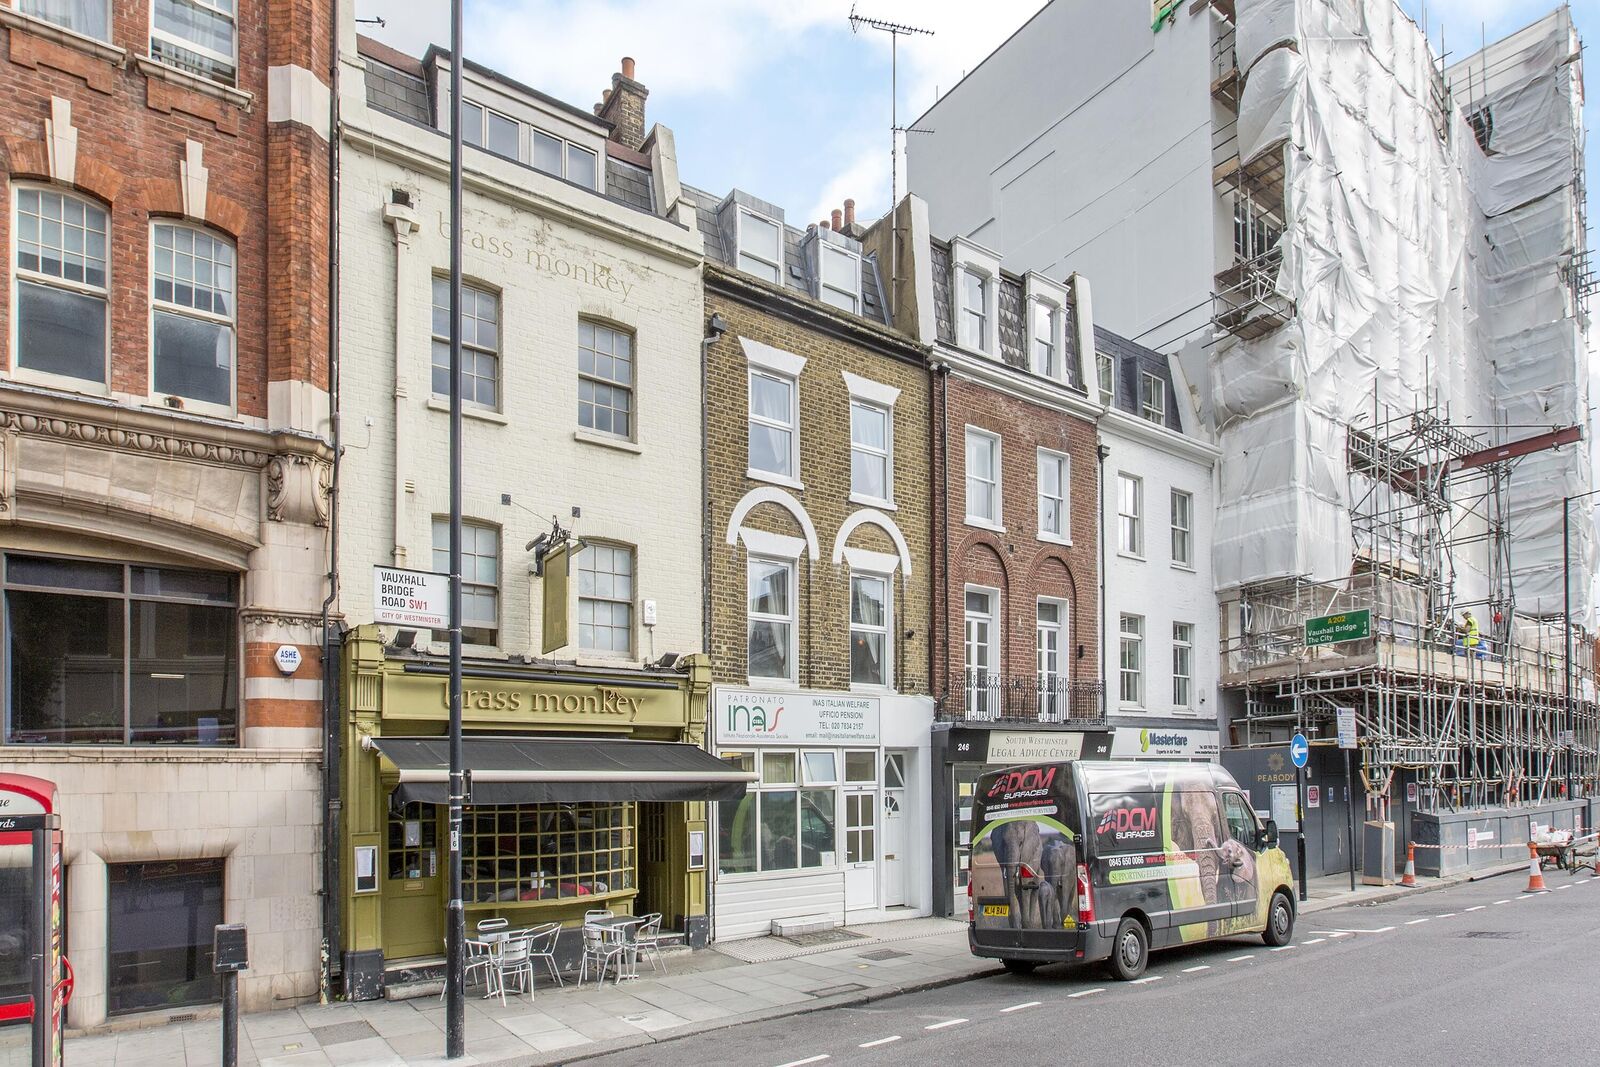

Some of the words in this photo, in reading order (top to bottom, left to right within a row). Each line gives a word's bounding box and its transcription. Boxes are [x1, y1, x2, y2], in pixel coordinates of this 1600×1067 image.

[526, 249, 634, 303] monkey
[381, 571, 427, 587] VAUXHALL
[381, 583, 415, 597] BRIDGE
[381, 596, 406, 608] ROAD
[408, 599, 428, 611] SW1
[381, 611, 394, 619] CITY
[403, 614, 441, 624] WESTMINSTER
[1327, 615, 1346, 625] A202
[1307, 626, 1335, 637] Vauxhall
[1335, 624, 1358, 632] Bridge
[1320, 634, 1334, 642] City
[280, 650, 297, 659] ASHE
[531, 685, 645, 722] monkey
[728, 694, 785, 705] PATRONATO
[812, 699, 825, 707] INAS
[826, 700, 845, 708] ITALIAN
[846, 701, 870, 709] WELFARE
[819, 711, 840, 719] UFFICIO
[840, 712, 864, 720] PENSIONI
[819, 722, 830, 730] TEL:
[831, 722, 840, 730] 020
[1005, 735, 1027, 745] SOUTH
[1028, 736, 1068, 745] WESTMINSTER
[1149, 732, 1188, 746] Masterfare
[991, 747, 1017, 758] LEGAL
[1019, 747, 1048, 758] ADVICE
[1049, 747, 1079, 758] CENTRE
[1006, 767, 1057, 792] DCM
[1257, 773, 1296, 782] PEABODY
[1003, 788, 1049, 800] SURFACES
[1116, 808, 1156, 832] DCM
[1115, 830, 1156, 839] SURFACES
[1108, 858, 1122, 867] 0845
[1122, 857, 1132, 866] 650
[1132, 856, 1145, 865] 0066
[1111, 870, 1146, 881] SUPPORTING
